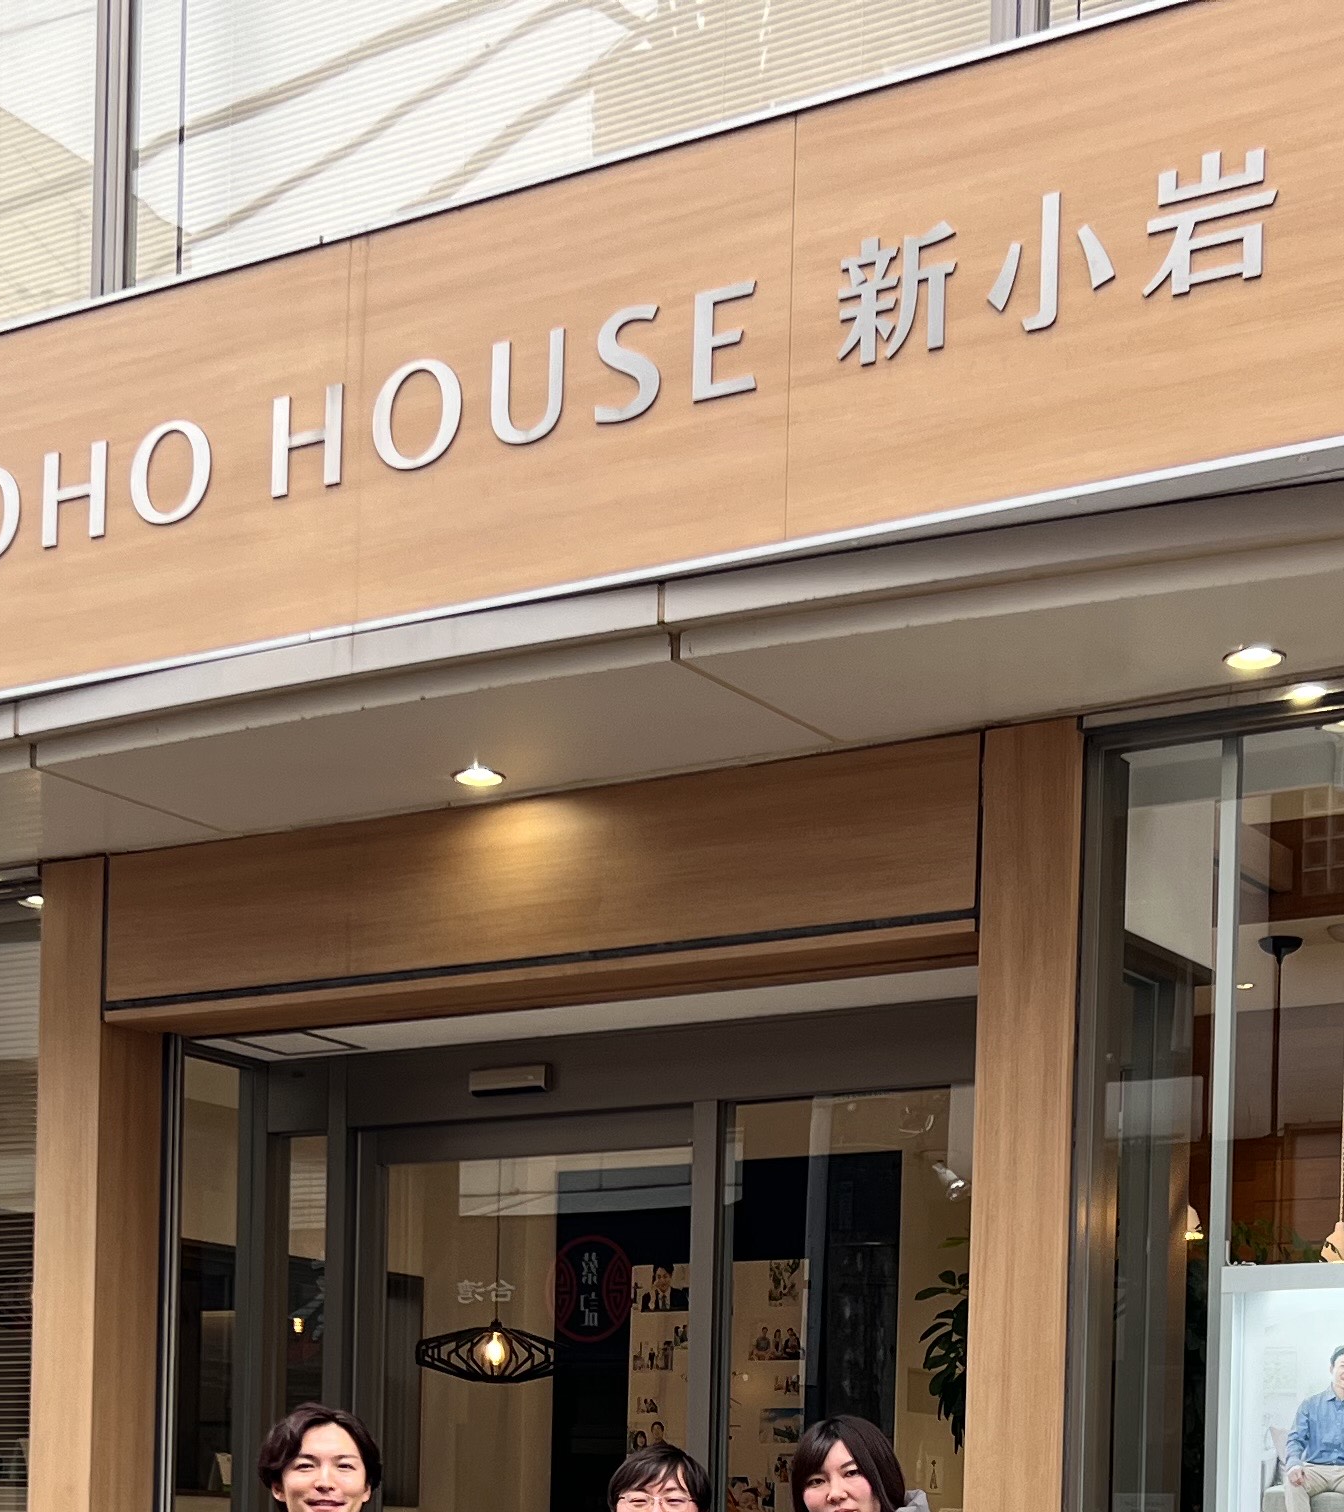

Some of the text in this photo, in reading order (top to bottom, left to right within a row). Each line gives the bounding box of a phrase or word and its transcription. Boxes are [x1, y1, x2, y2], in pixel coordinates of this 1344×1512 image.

[271, 280, 758, 498] HOUSE
[836, 147, 1279, 366] 新小岩
